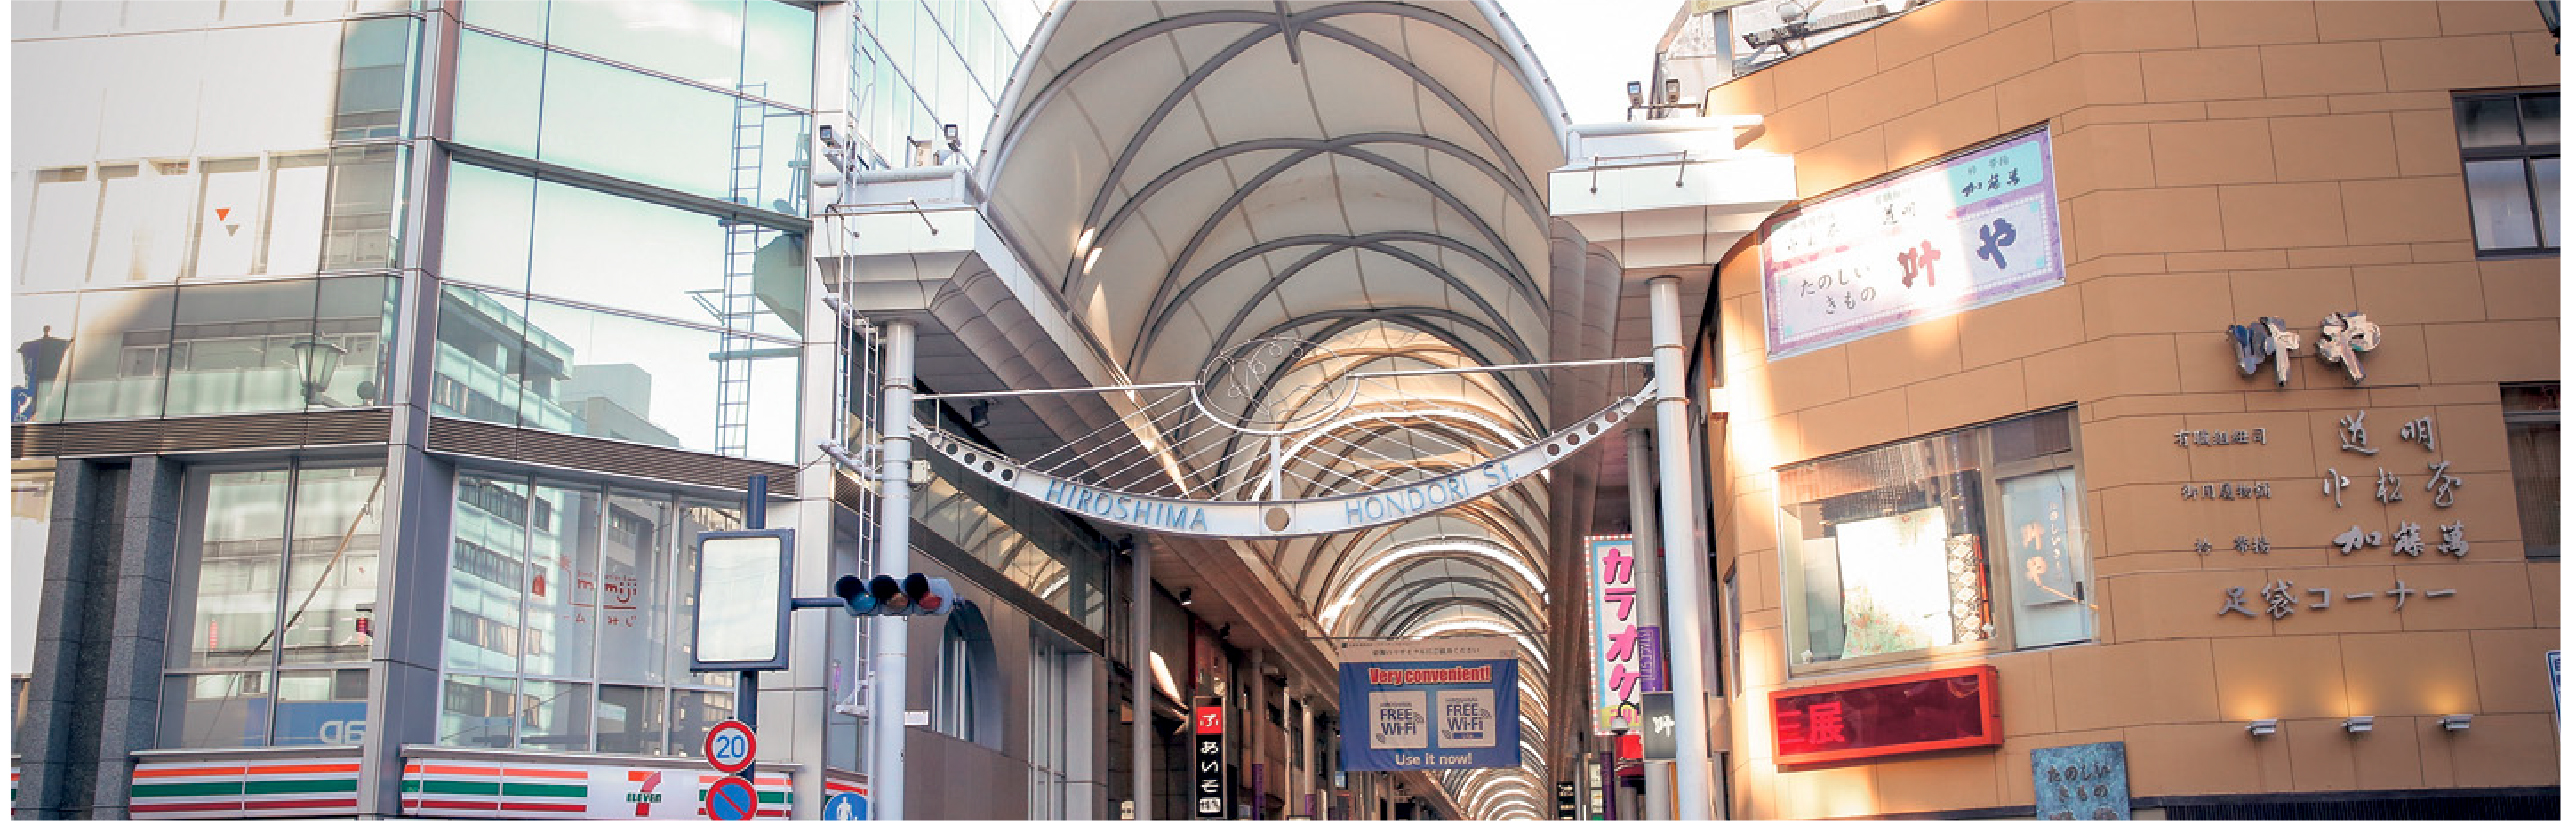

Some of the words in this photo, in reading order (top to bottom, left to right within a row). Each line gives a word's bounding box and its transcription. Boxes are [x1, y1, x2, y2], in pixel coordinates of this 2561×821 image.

[1800, 264, 1871, 297] たのしい
[1825, 286, 1876, 315] きもの
[1045, 478, 1207, 532] HIROSHIMA
[1345, 473, 1469, 525] HONDORI
[1482, 460, 1519, 489] St.
[2217, 578, 2459, 620] 足袋コーナー
[1602, 547, 1641, 702] カラオケ
[1368, 667, 1405, 686] Very
[1404, 664, 1492, 684] convenient!
[1379, 708, 1413, 721] FREE
[1446, 704, 1479, 717] FREE
[715, 735, 746, 759] 20
[1395, 753, 1421, 766] Use
[1425, 752, 1436, 765] it
[1439, 752, 1473, 765] now!
[627, 770, 662, 818] 7
